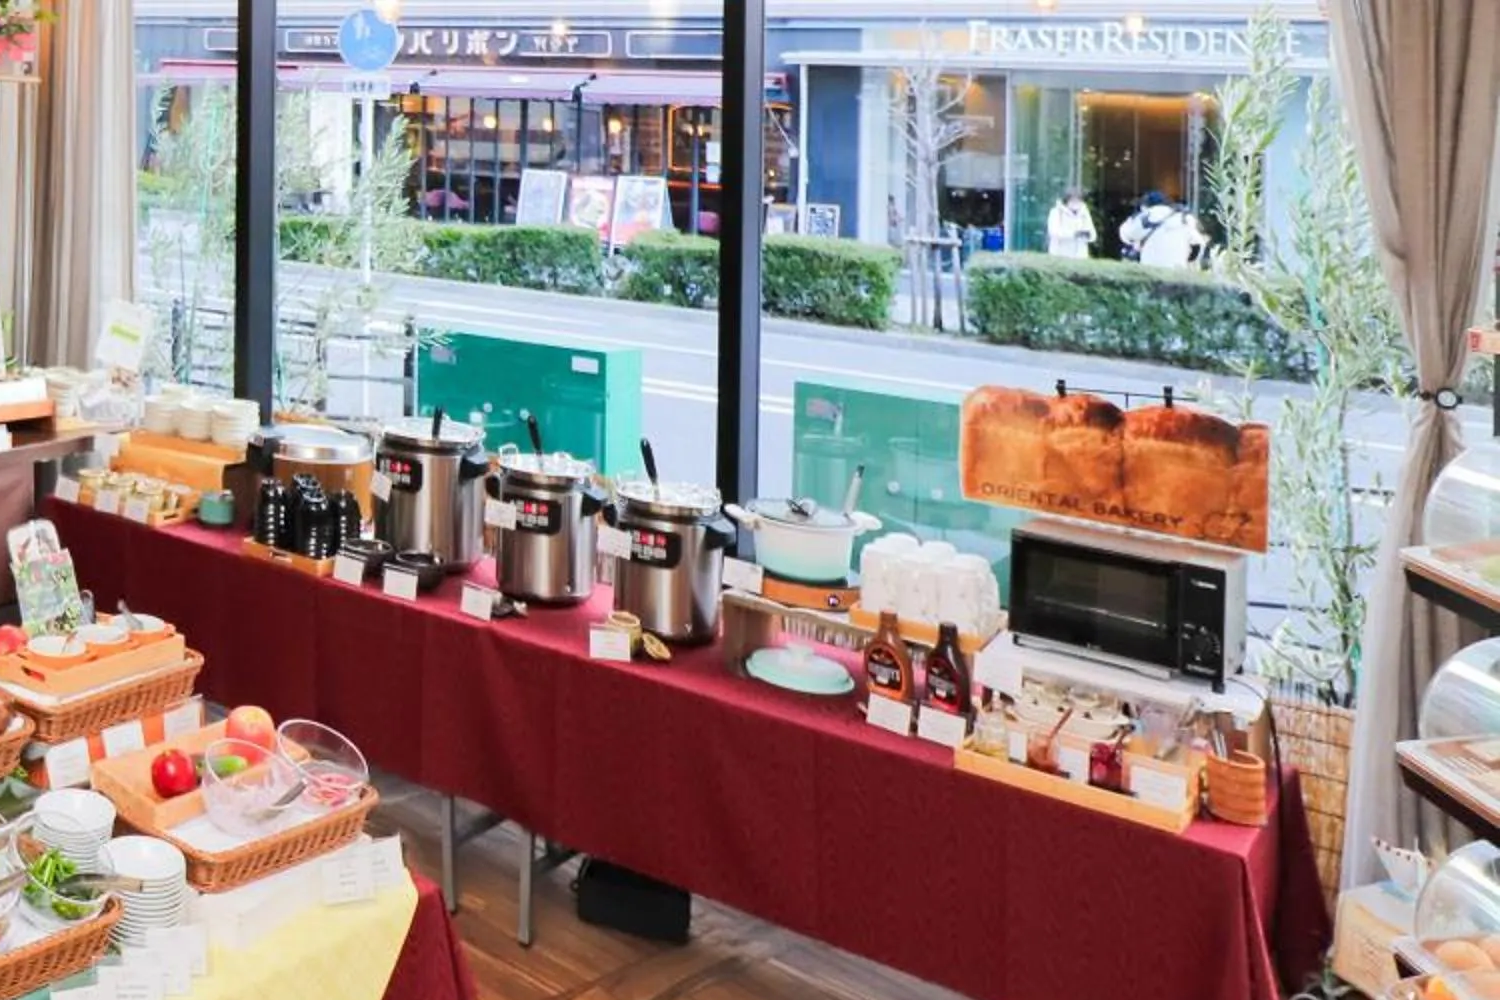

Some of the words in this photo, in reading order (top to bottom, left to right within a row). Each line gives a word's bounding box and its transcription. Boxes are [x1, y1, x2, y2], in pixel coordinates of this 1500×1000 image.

[966, 20, 1098, 51] FRASER
[1101, 21, 1302, 56] RESIDENE
[981, 482, 1082, 512] ORIENTAL
[1093, 502, 1184, 527] BAKERY
